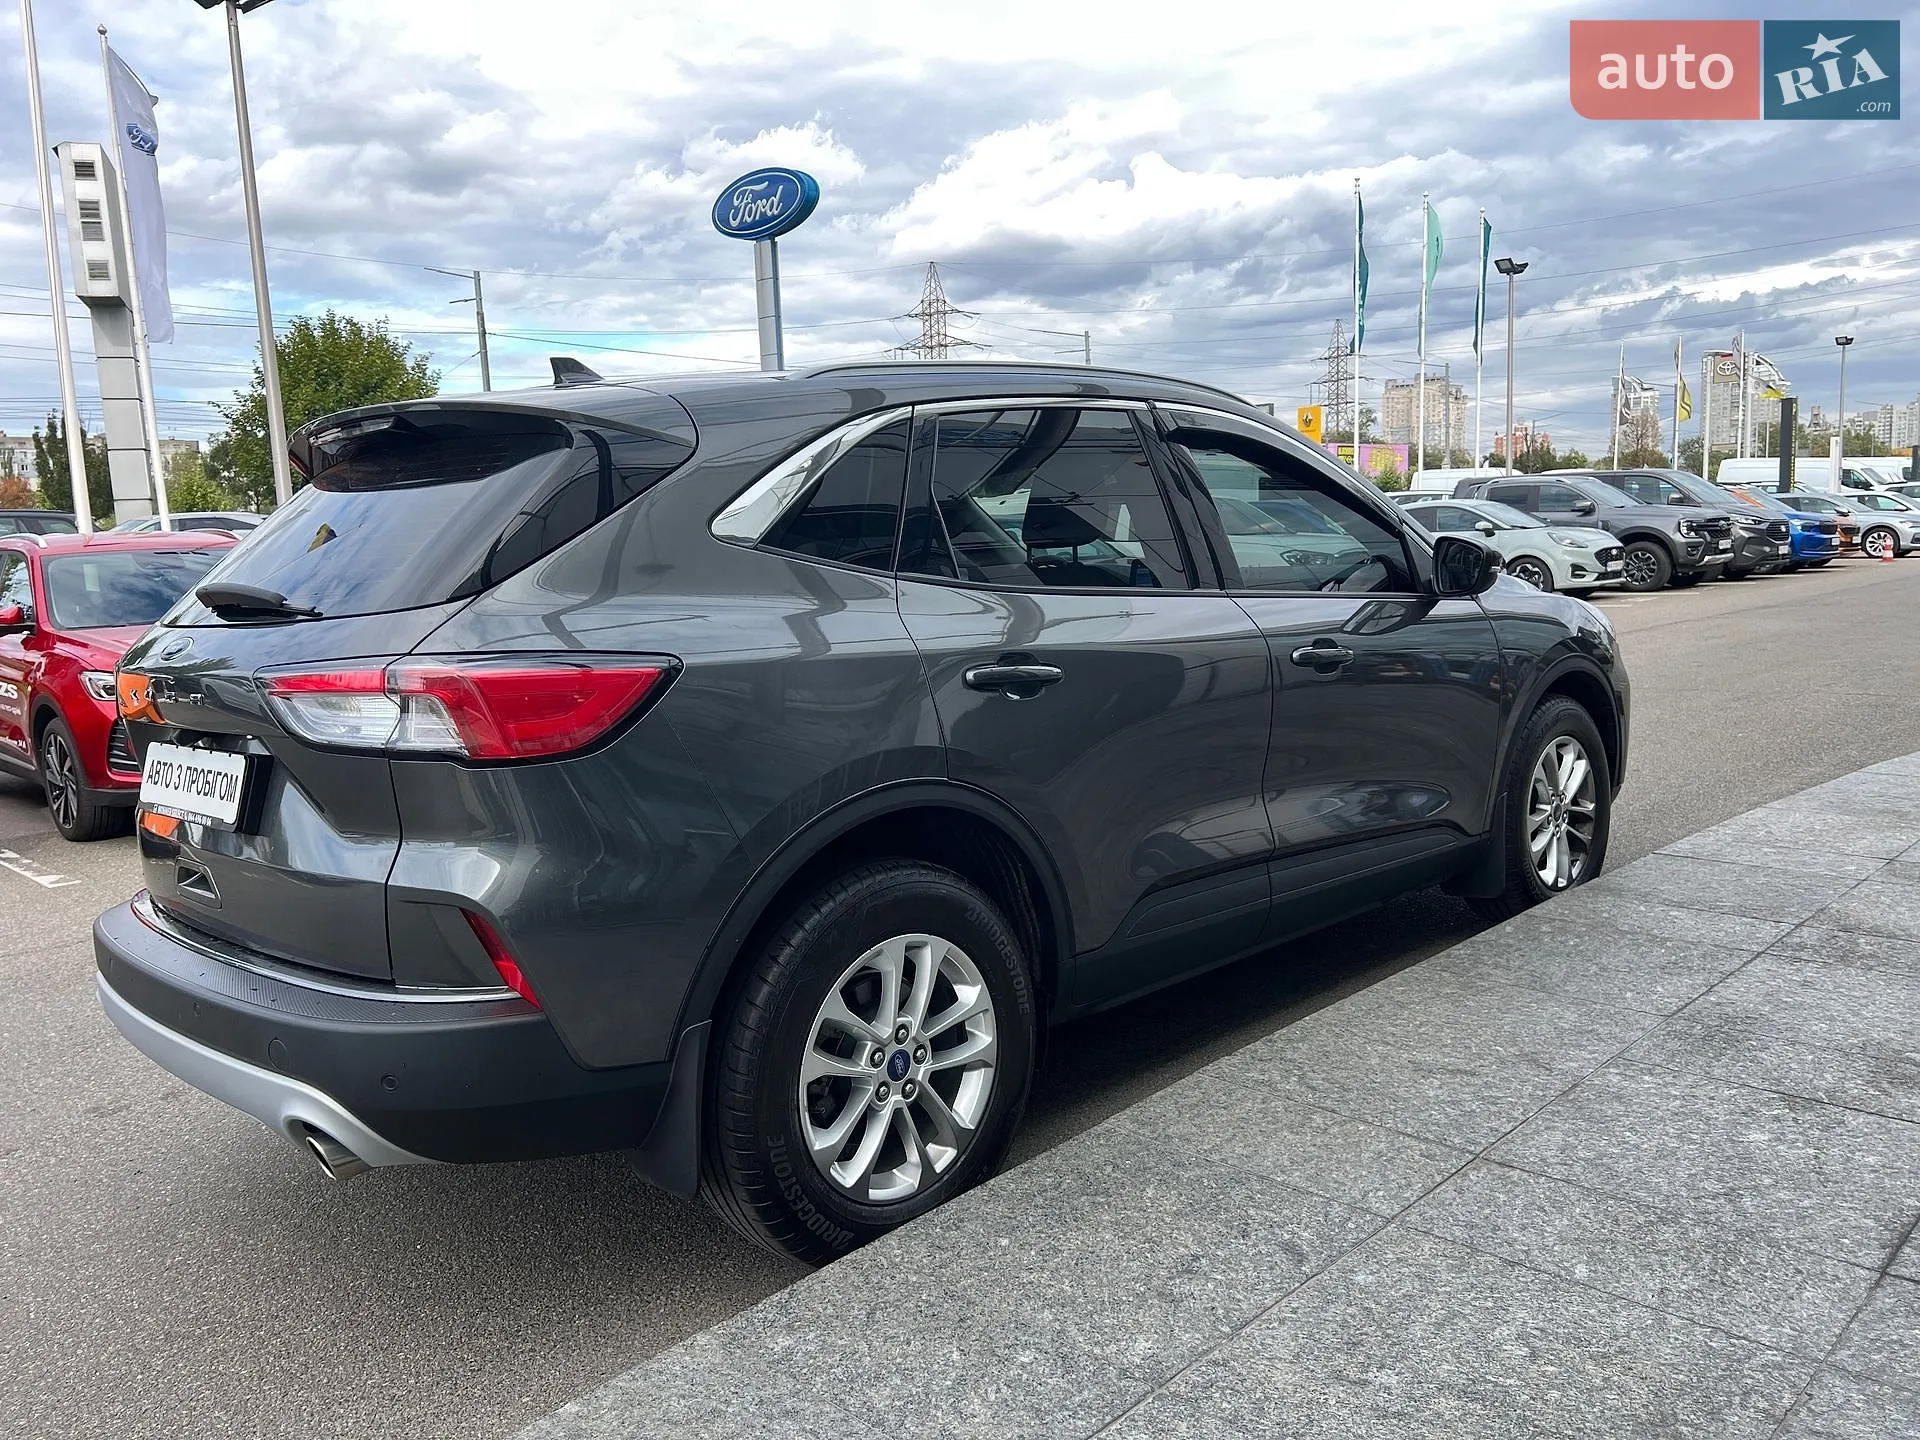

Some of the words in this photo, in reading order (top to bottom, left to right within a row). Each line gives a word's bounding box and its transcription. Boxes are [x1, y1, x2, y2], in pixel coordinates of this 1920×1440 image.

[729, 181, 783, 227] Ford
[147, 760, 174, 789] АВТО
[183, 765, 239, 803] ПРОБІГОМ
[964, 903, 1030, 1016] BRIDGESTONE
[767, 1134, 855, 1250] BRIDGESTONE
